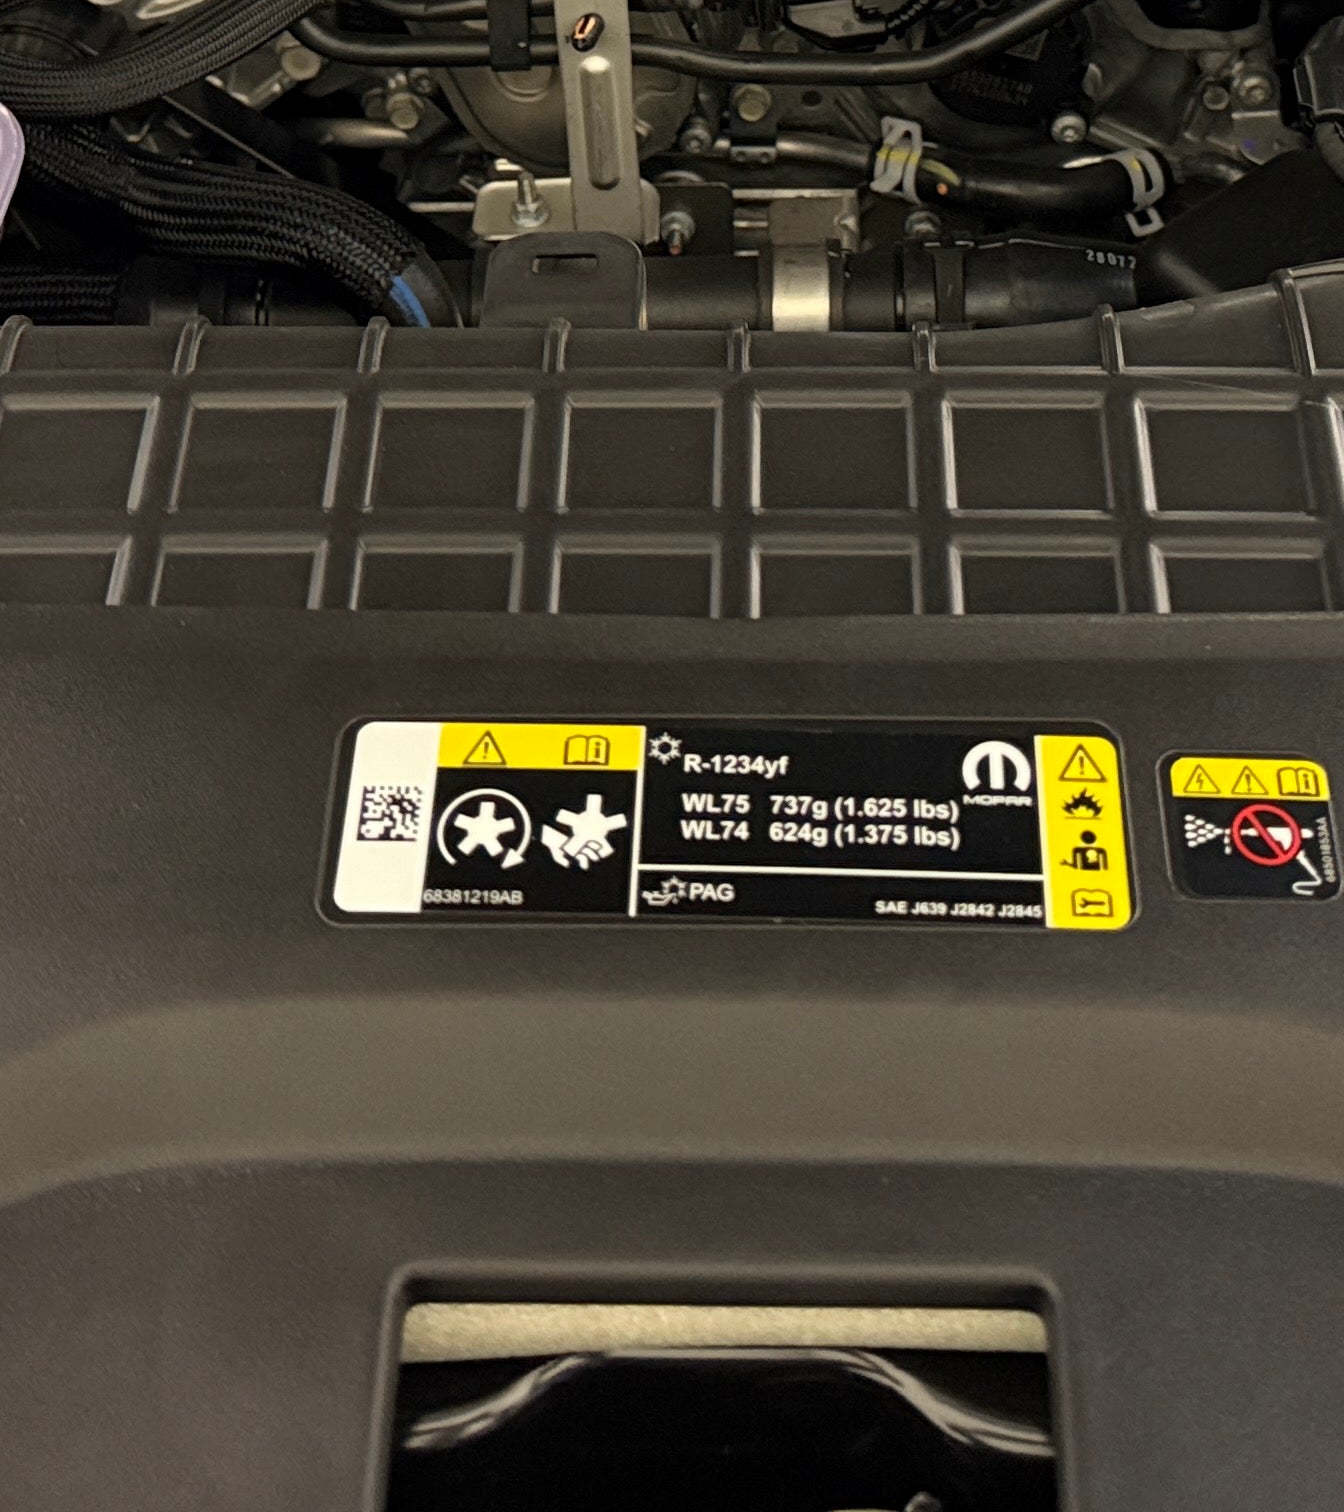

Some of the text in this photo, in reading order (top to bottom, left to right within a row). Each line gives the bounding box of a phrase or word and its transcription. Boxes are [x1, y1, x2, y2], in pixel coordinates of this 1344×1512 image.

[682, 753, 790, 781] R-1234yf
[681, 792, 961, 824] WL75 737g (1.625 lbs)
[962, 794, 1033, 807] MOPAR
[680, 819, 962, 851] WL74 624g (1.375 lbs)
[423, 888, 524, 905] 68381219AB
[689, 882, 735, 903] PAG
[875, 900, 1044, 919] SAE J639 J2842 J2845
